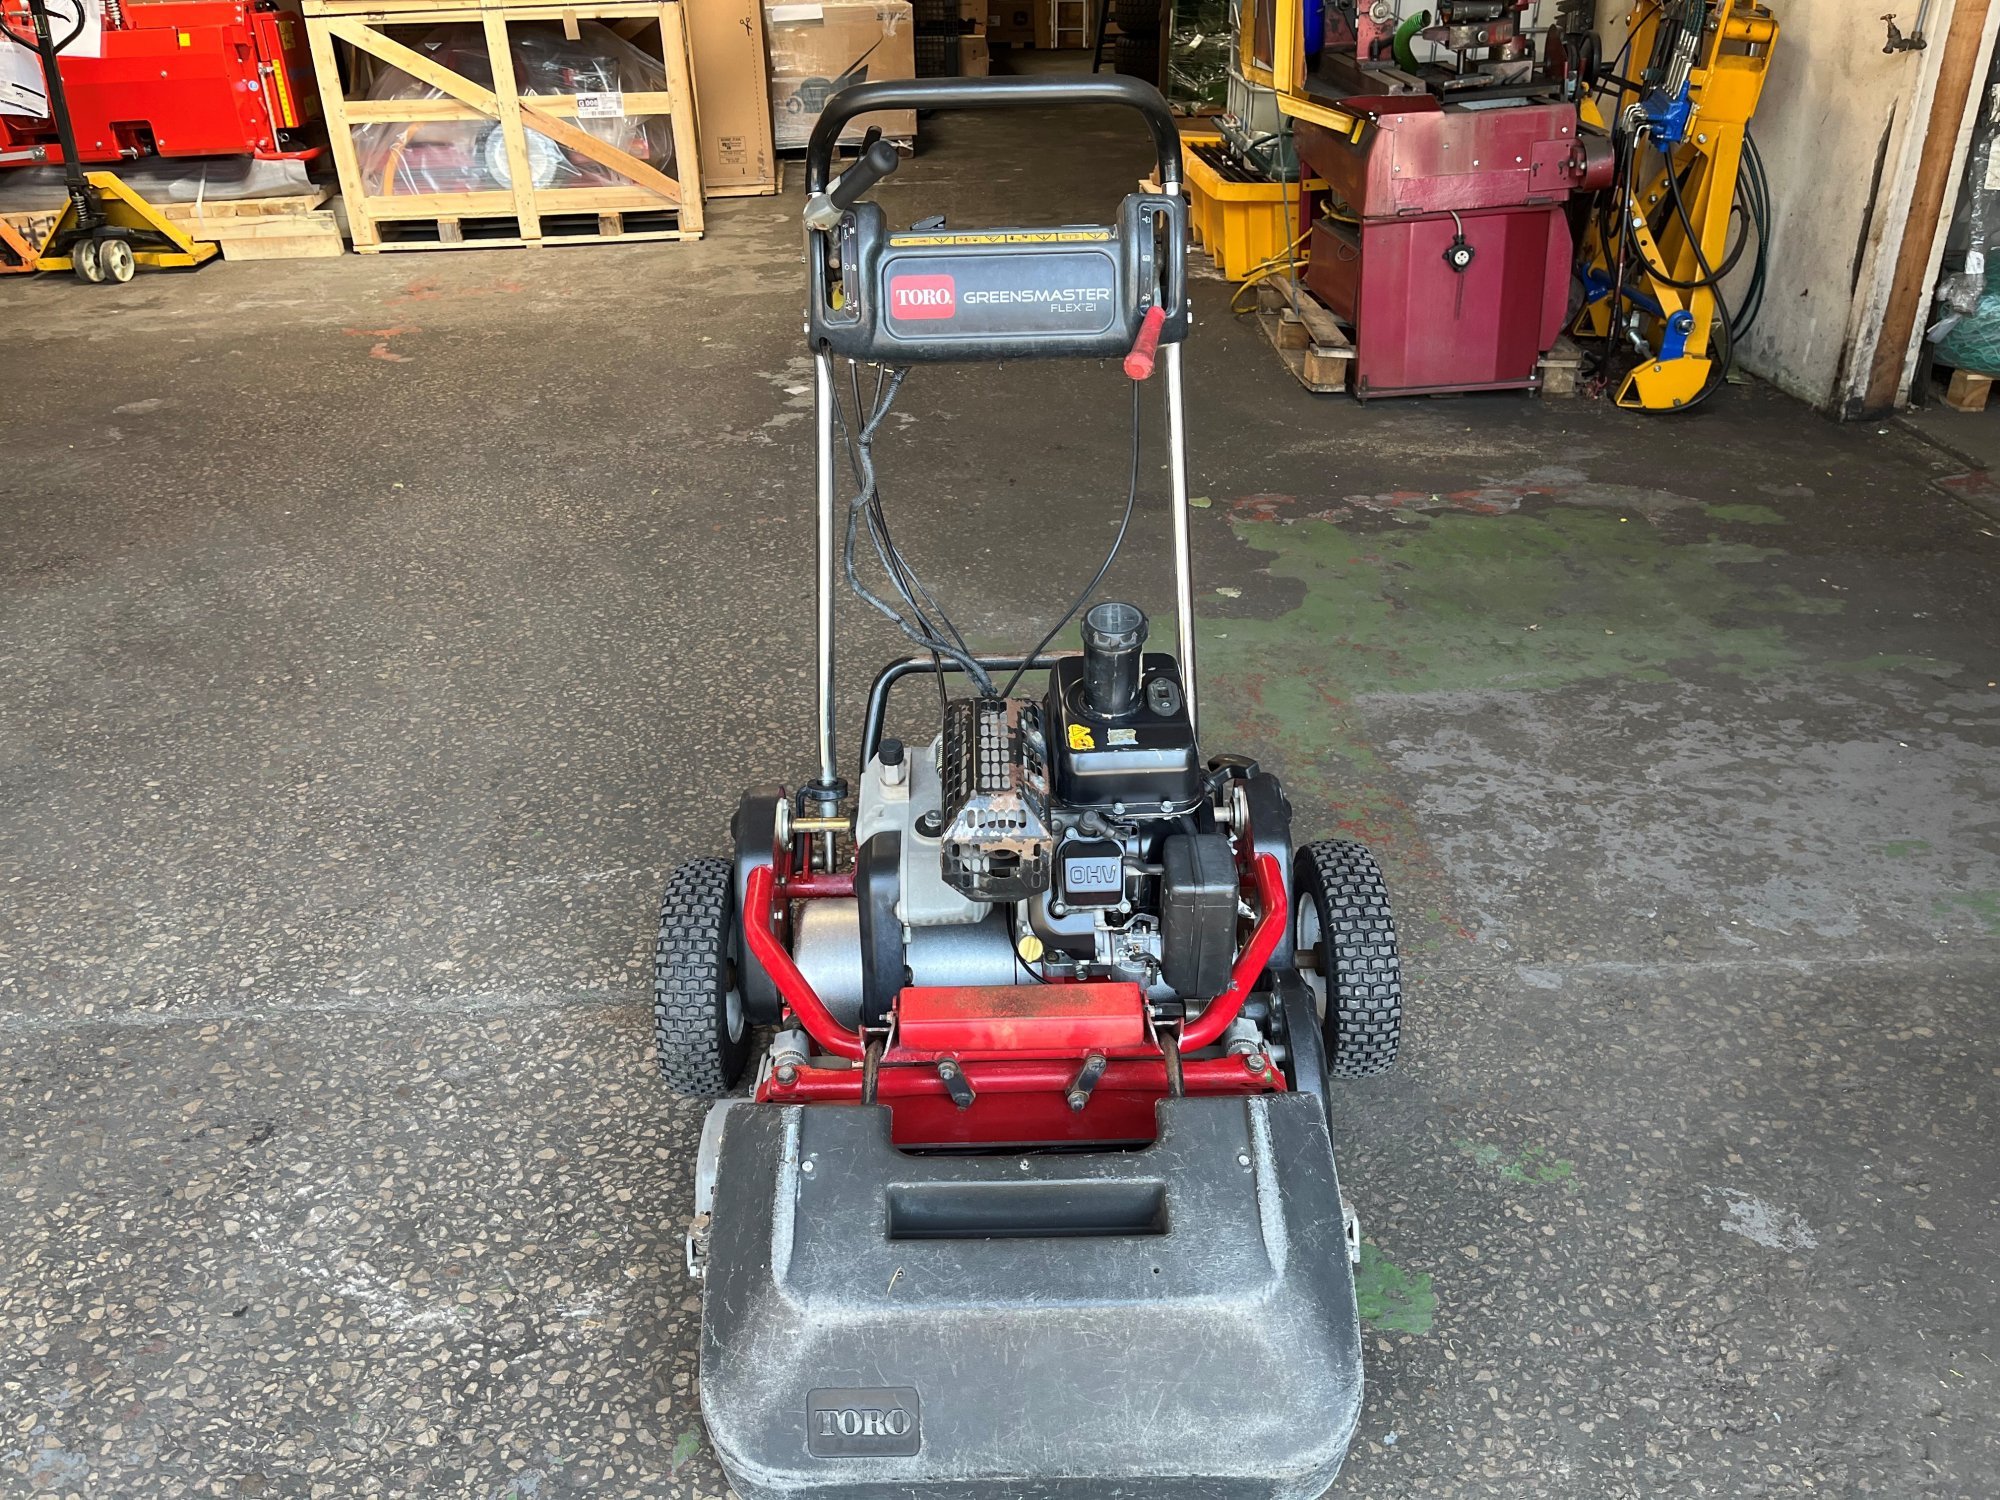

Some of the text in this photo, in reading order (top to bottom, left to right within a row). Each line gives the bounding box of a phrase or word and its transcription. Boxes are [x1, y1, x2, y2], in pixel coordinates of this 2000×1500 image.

[876, 12, 907, 21] SIHL
[896, 288, 951, 306] TORO
[963, 288, 1111, 304] GREENSMASTER
[1050, 303, 1083, 313] FLEX
[1070, 865, 1117, 884] OHV
[814, 1408, 912, 1436] TORO
